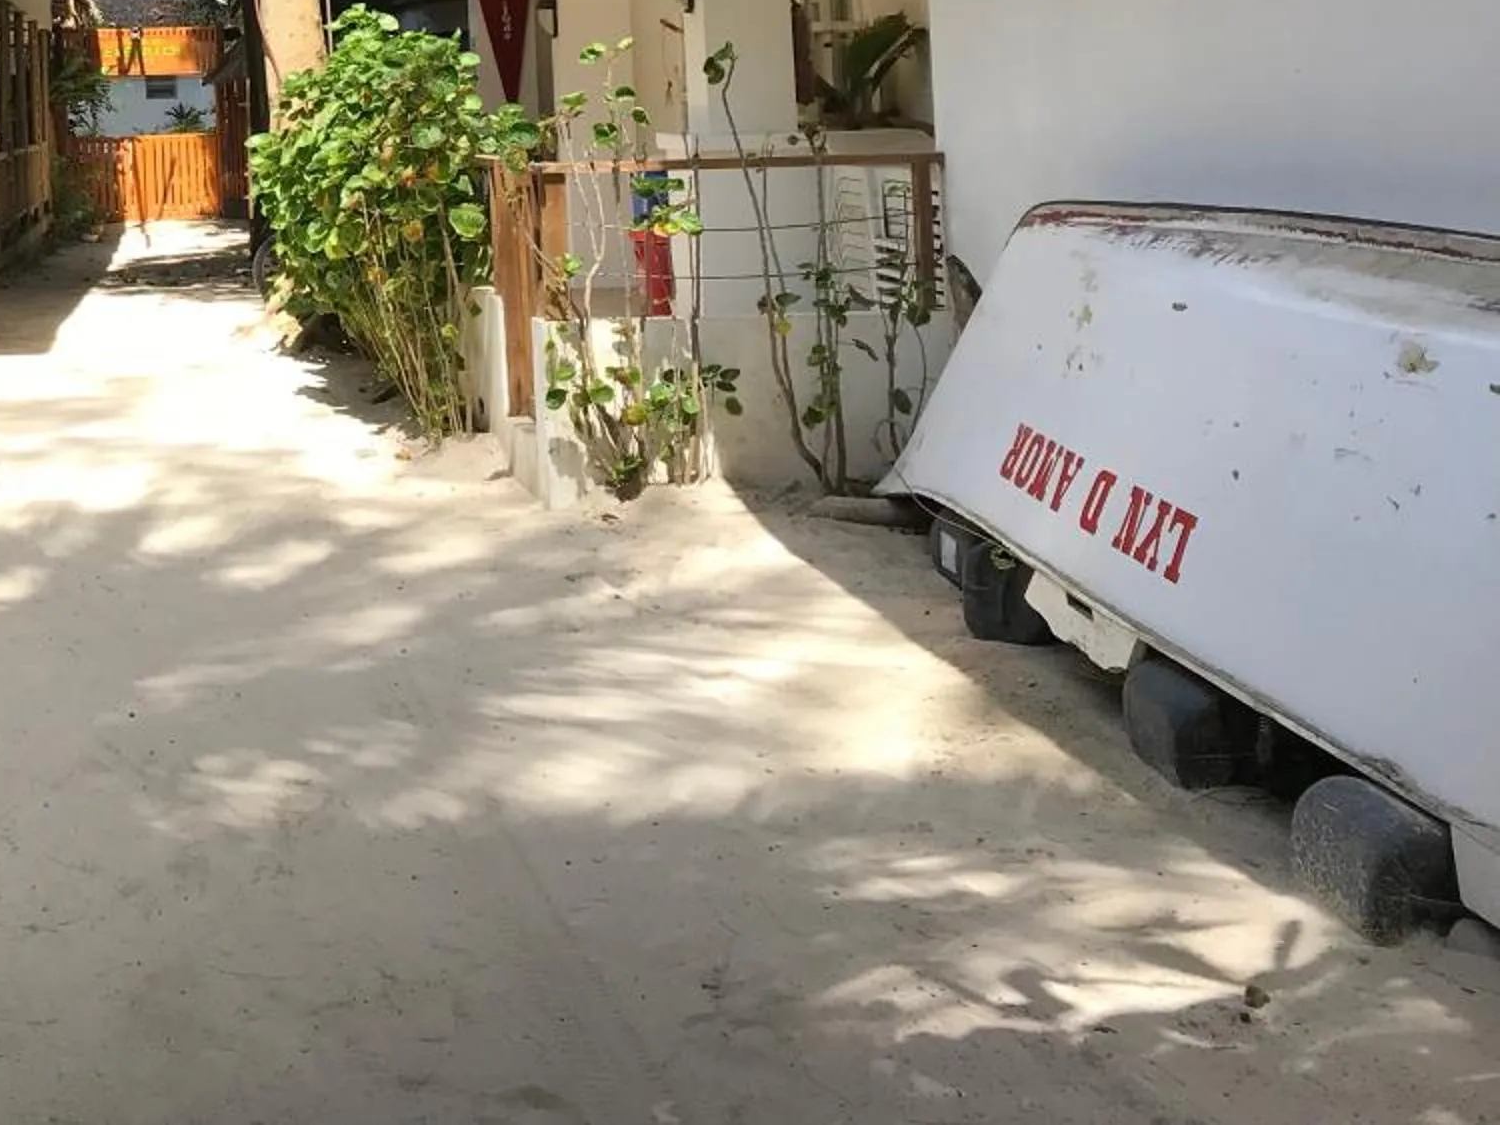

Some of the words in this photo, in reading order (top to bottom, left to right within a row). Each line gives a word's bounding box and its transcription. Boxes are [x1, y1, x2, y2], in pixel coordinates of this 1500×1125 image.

[1000, 422, 1086, 512] AMOR
[1079, 469, 1118, 535] D
[1111, 485, 1199, 584] LYN
